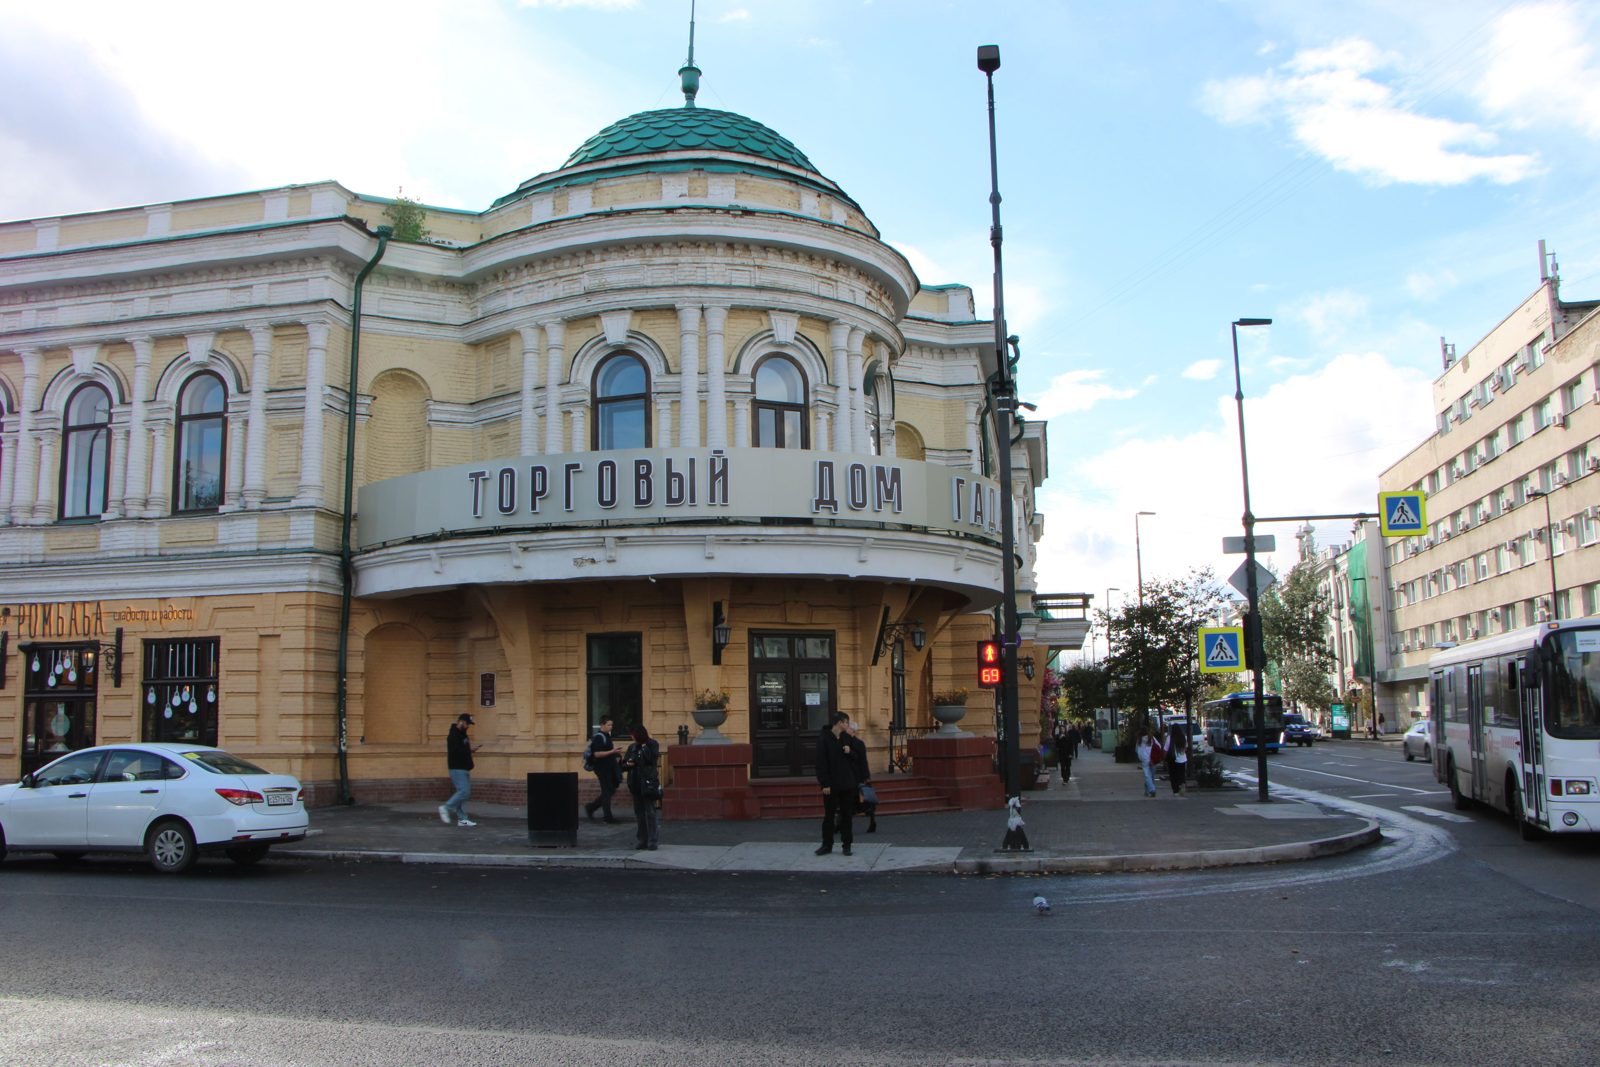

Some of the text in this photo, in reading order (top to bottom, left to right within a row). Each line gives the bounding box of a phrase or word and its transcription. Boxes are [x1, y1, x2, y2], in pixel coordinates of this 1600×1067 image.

[468, 449, 1002, 535] ТОРГОВЫЙ ДОМ ГАД
[17, 601, 105, 639] РОМБАБА
[159, 604, 193, 623] радости
[982, 668, 999, 683] 69
